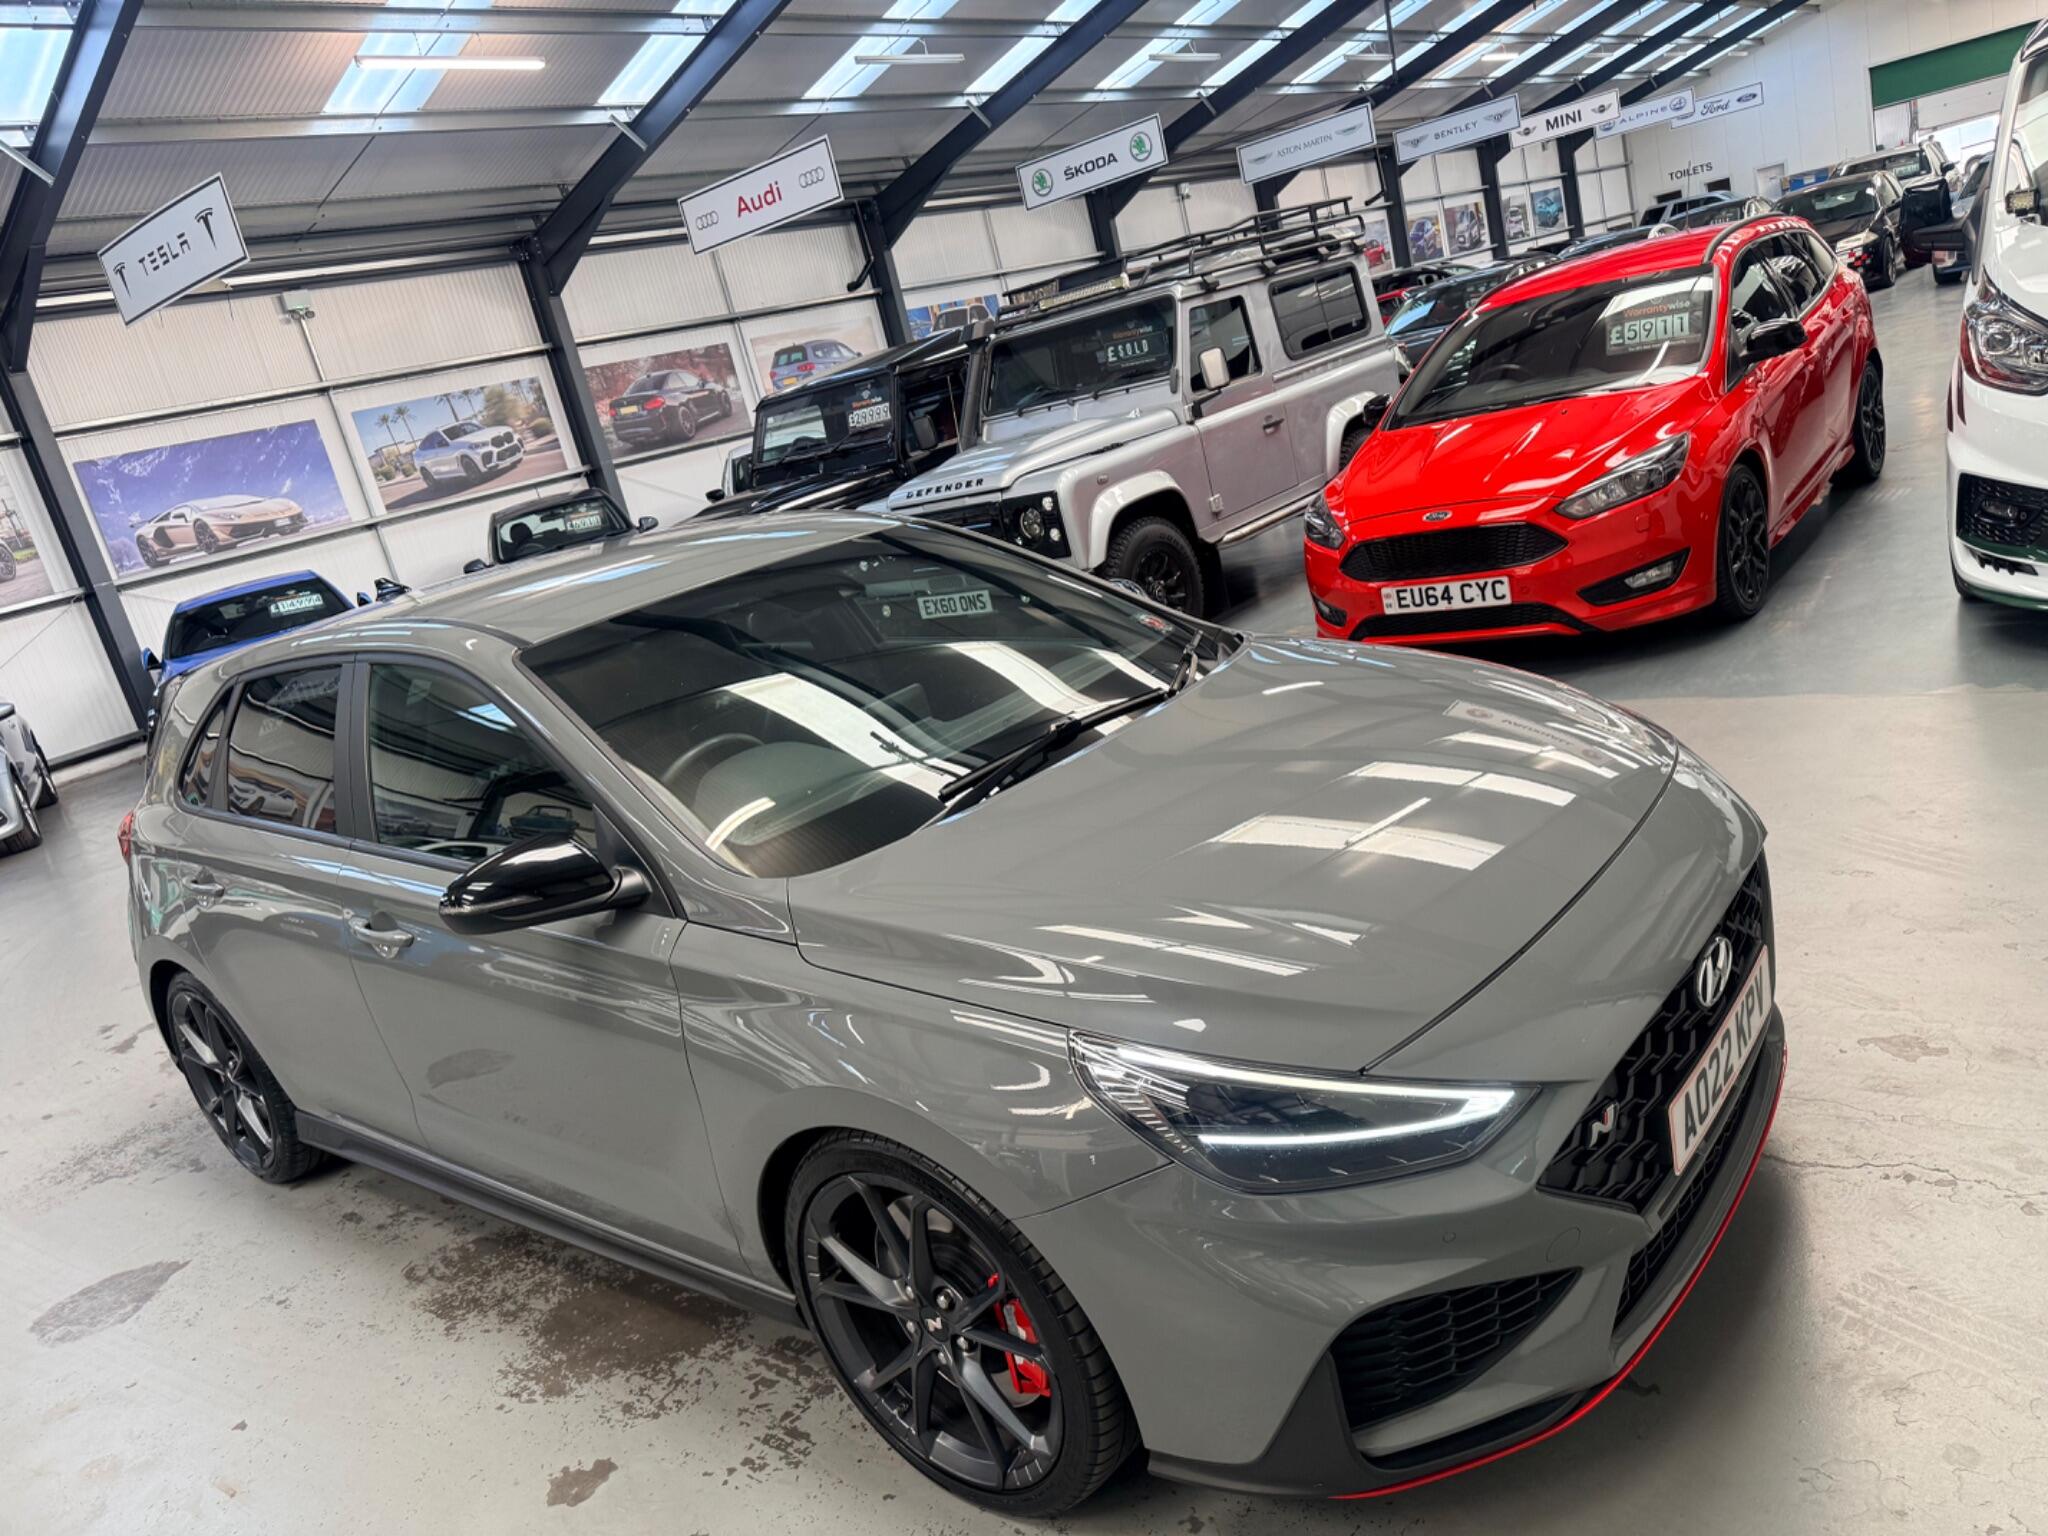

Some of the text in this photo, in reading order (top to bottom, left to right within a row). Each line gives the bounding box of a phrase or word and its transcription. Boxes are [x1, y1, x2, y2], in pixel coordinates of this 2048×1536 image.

[1619, 105, 1669, 124] ALPINE
[1700, 99, 1731, 117] Ford
[1433, 120, 1479, 141] BENTLEY
[1545, 109, 1582, 132] MINI
[1277, 133, 1333, 158] ASTON MARTIN
[1063, 152, 1118, 181] ŠKODA
[1668, 161, 1713, 182] TOILETS
[737, 180, 783, 218] Audi
[138, 231, 192, 277] TESLA
[906, 478, 984, 500] DEFENDER
[923, 593, 987, 616] EX60 ONS
[1395, 584, 1454, 609] EU64
[1460, 579, 1507, 603] CYC
[1684, 965, 1764, 1150] AO22 KPV
